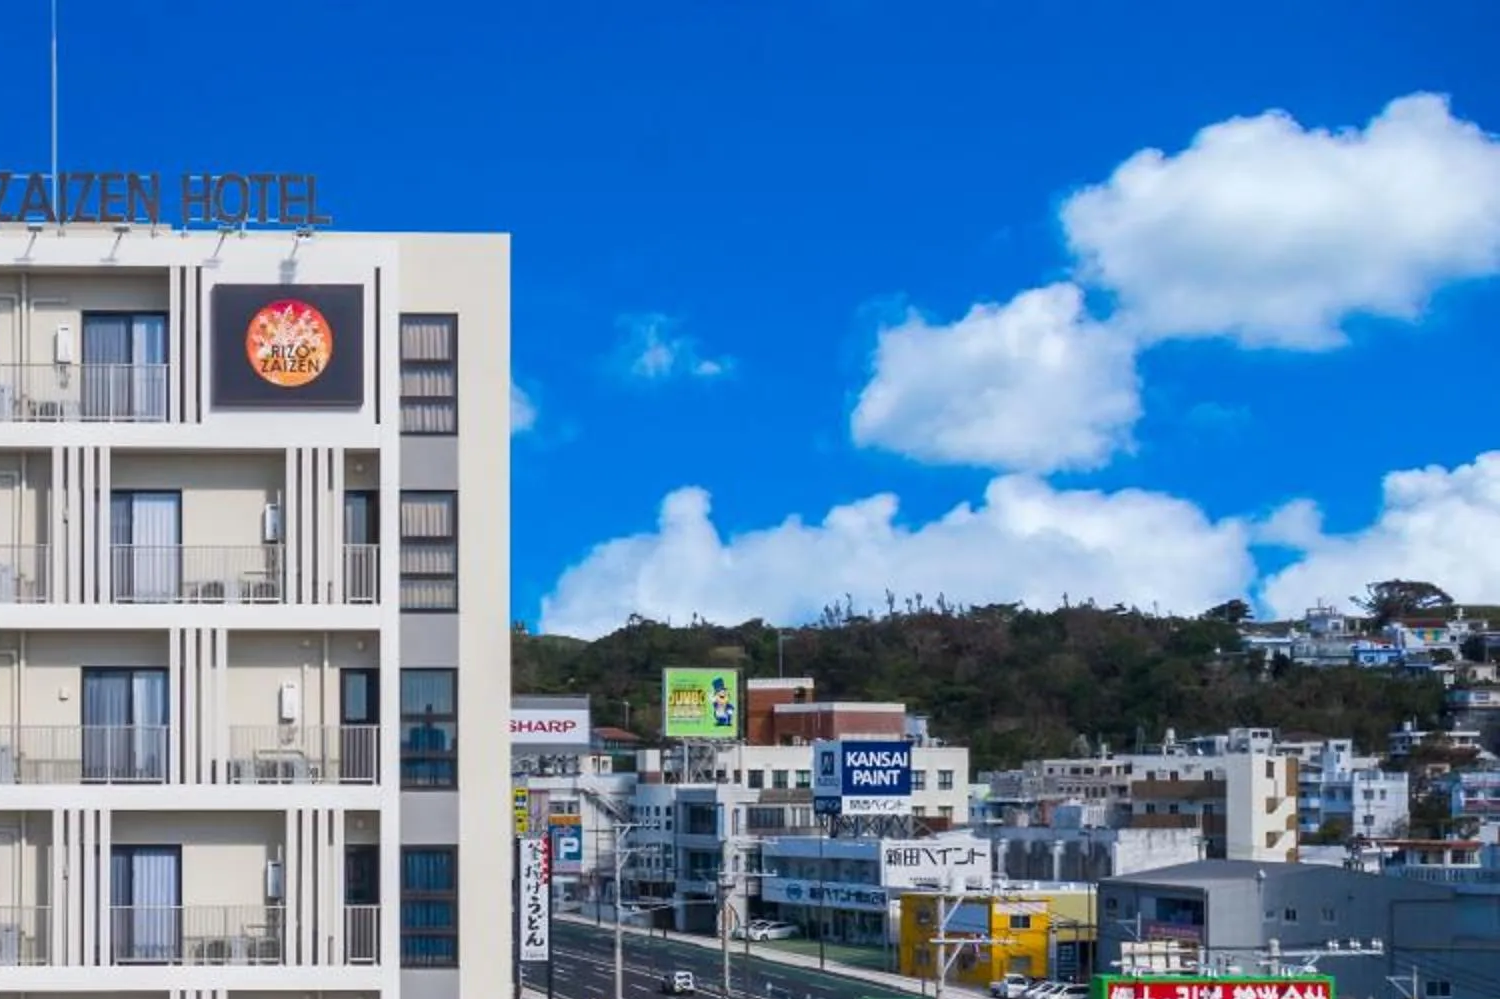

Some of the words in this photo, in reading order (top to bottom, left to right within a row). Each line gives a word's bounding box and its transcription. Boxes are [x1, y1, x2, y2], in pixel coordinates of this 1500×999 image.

[182, 172, 333, 225] HOTEL
[271, 344, 311, 359] RIZO
[261, 359, 320, 373] ZAIZEN
[510, 720, 577, 733] SHARP
[846, 751, 908, 767] KANSAI
[852, 769, 900, 785] PAINT
